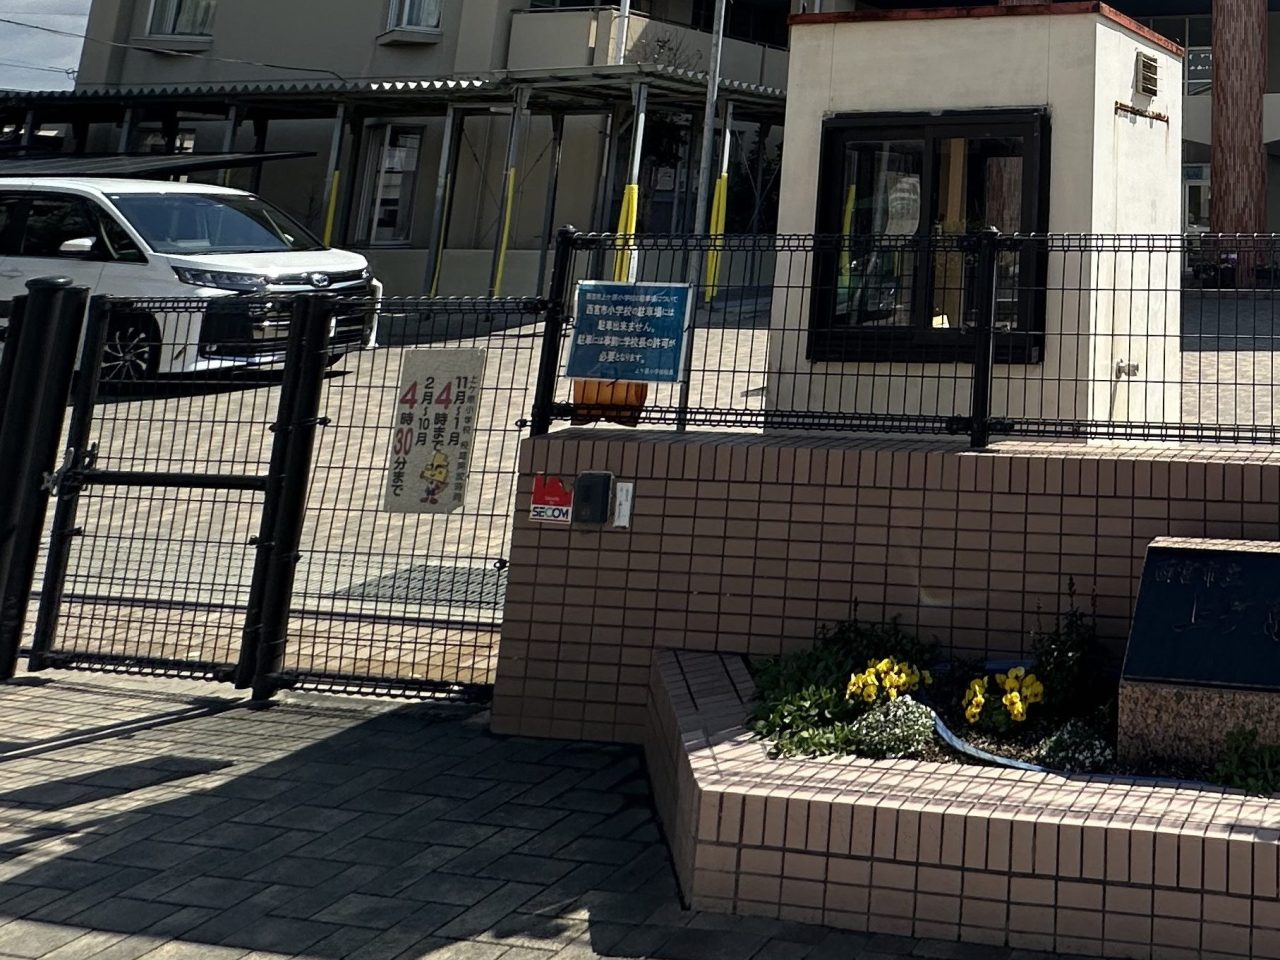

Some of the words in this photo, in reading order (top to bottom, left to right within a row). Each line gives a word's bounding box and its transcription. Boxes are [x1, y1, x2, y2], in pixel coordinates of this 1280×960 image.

[391, 381, 418, 497] 4時30分まで
[432, 381, 452, 451] 4時まで
[532, 507, 569, 519] SECOM
